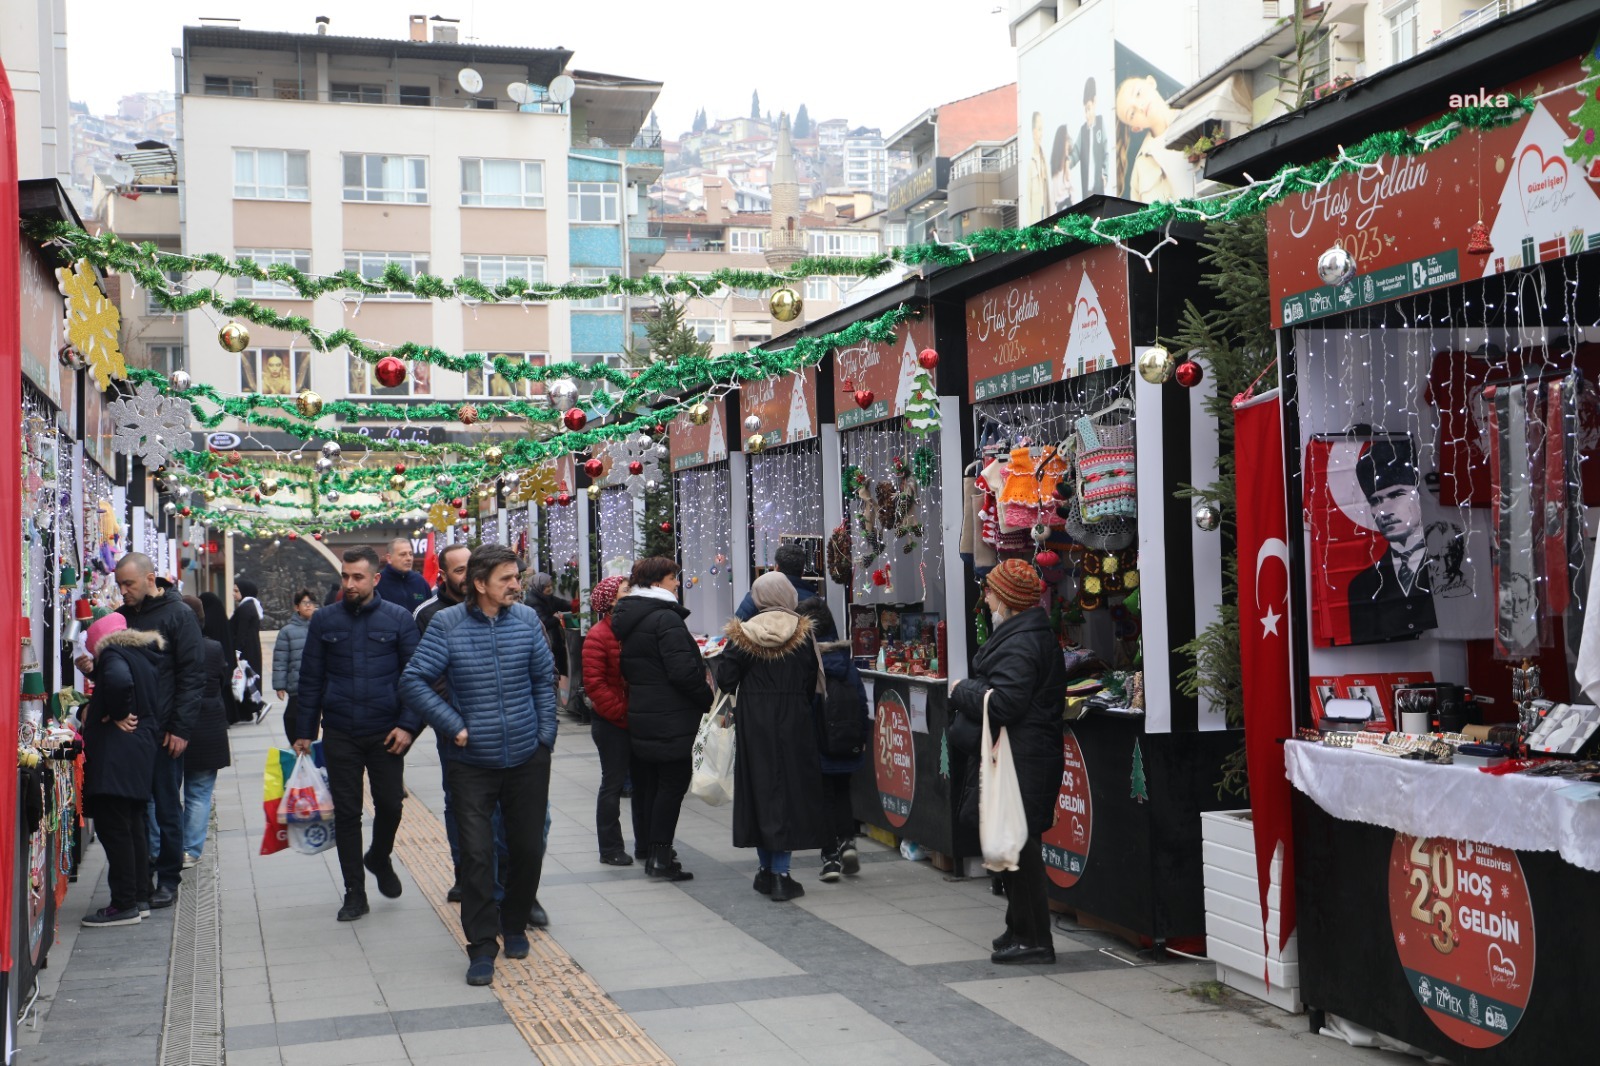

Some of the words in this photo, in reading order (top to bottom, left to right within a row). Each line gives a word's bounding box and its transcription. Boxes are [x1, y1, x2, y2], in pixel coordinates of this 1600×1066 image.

[1290, 183, 1352, 238] Hoş
[1355, 154, 1428, 230] Geldin
[1334, 226, 1383, 262] 023
[1426, 257, 1438, 265] T.C.
[1427, 263, 1443, 276] İZMİT
[1428, 269, 1457, 285] BELEDİYESİ
[977, 297, 1007, 343] Hoş
[1007, 288, 1040, 341] Geldin
[998, 339, 1021, 366] 2023
[893, 752, 911, 769] GELDİN
[1061, 770, 1074, 792] OŞ
[1058, 793, 1086, 816] GELDİN
[1475, 856, 1512, 873] BELEDİYESİ
[1457, 868, 1493, 906] HOŞ
[1458, 905, 1520, 945] GELDİN
